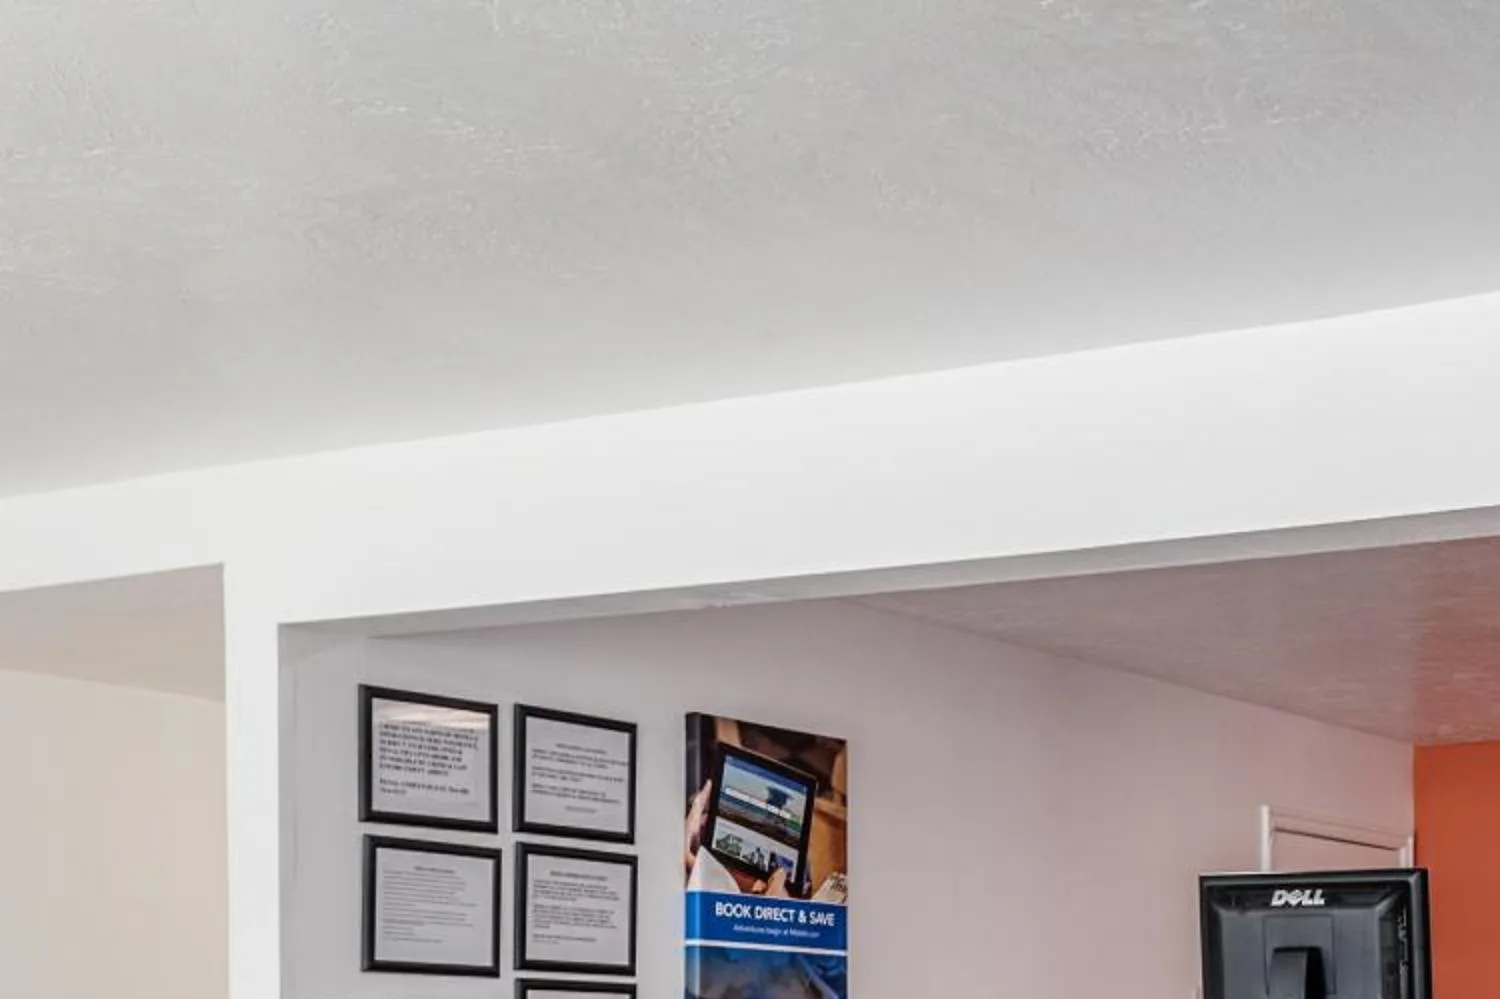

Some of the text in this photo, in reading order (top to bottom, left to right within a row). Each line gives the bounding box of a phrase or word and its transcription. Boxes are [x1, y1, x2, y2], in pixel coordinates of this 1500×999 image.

[1270, 889, 1325, 907] DELL
[715, 901, 835, 927] BOOK DIRECT & SAVE
